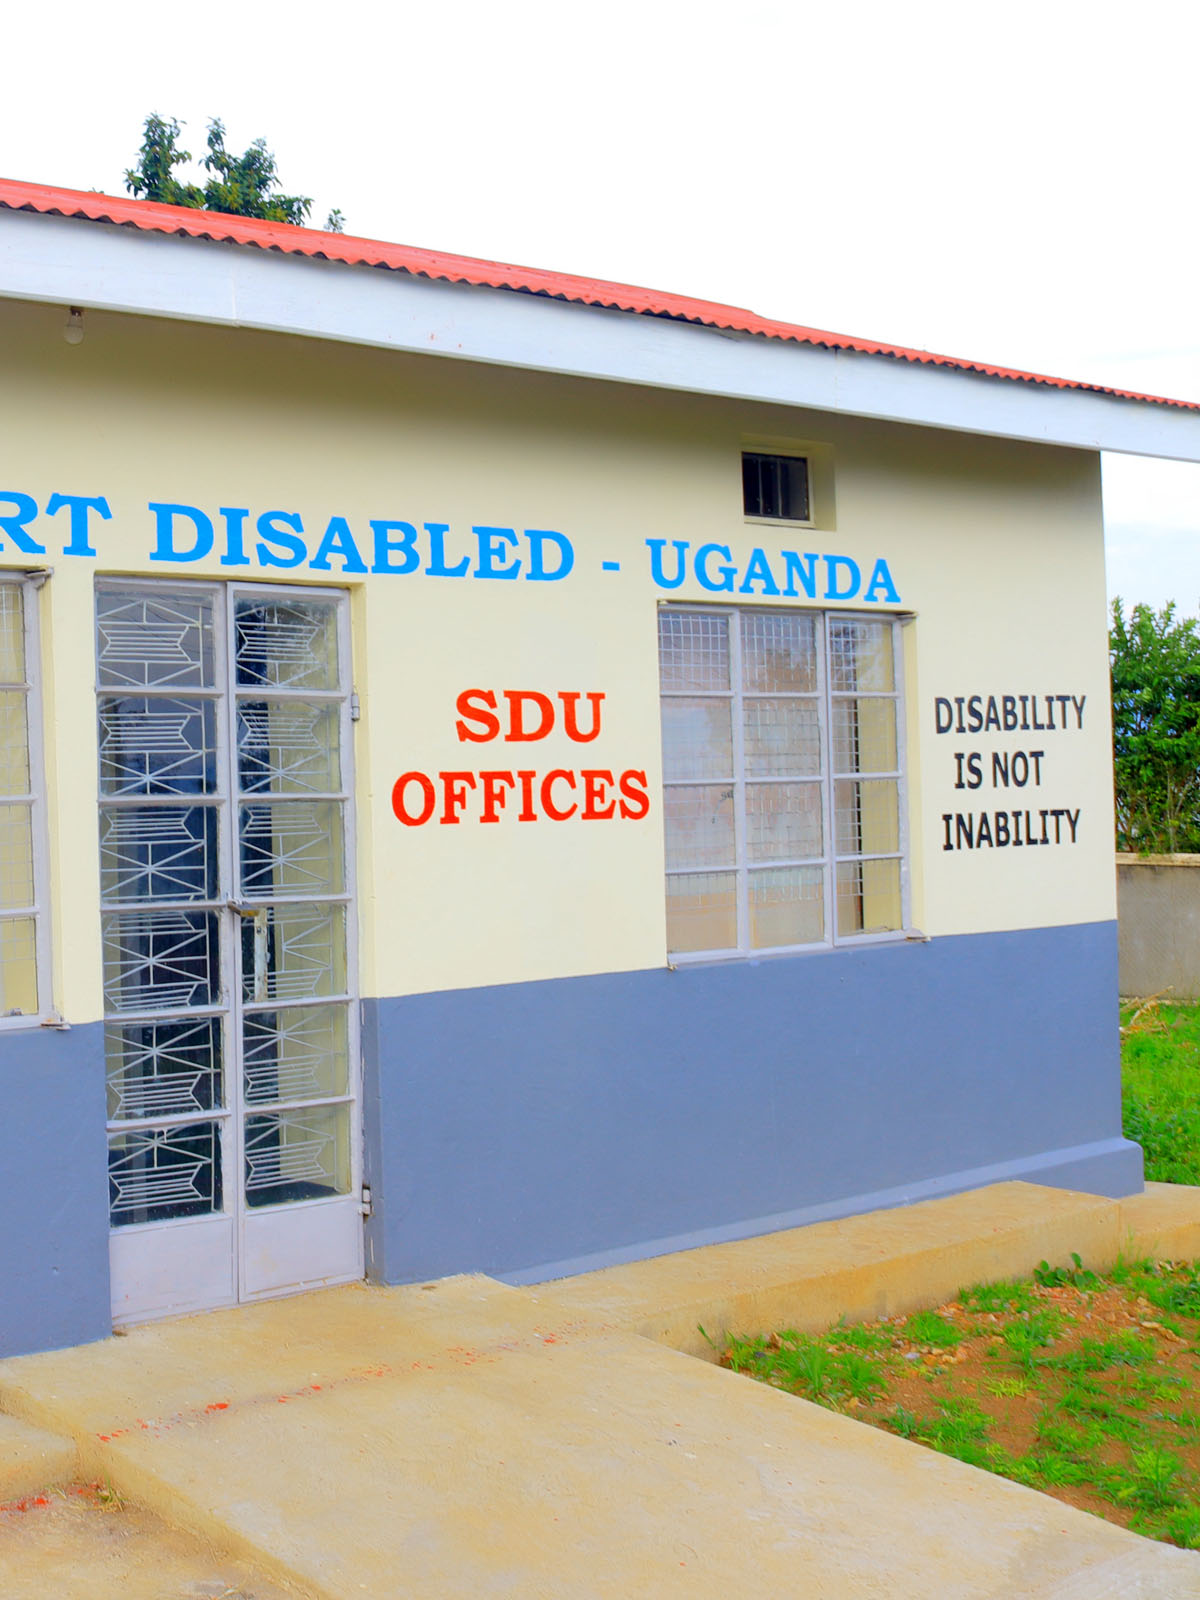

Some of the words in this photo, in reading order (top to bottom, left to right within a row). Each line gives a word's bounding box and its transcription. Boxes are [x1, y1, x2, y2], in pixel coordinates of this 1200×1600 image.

[149, 502, 575, 581] DISABLED
[645, 539, 901, 603] UGANDA
[455, 688, 606, 743] SDU
[935, 695, 1087, 734] DISABILITY
[954, 753, 982, 790] IS
[992, 751, 1044, 788] NOT
[392, 769, 650, 827] OFFICES
[942, 809, 1081, 851] INABILITY
